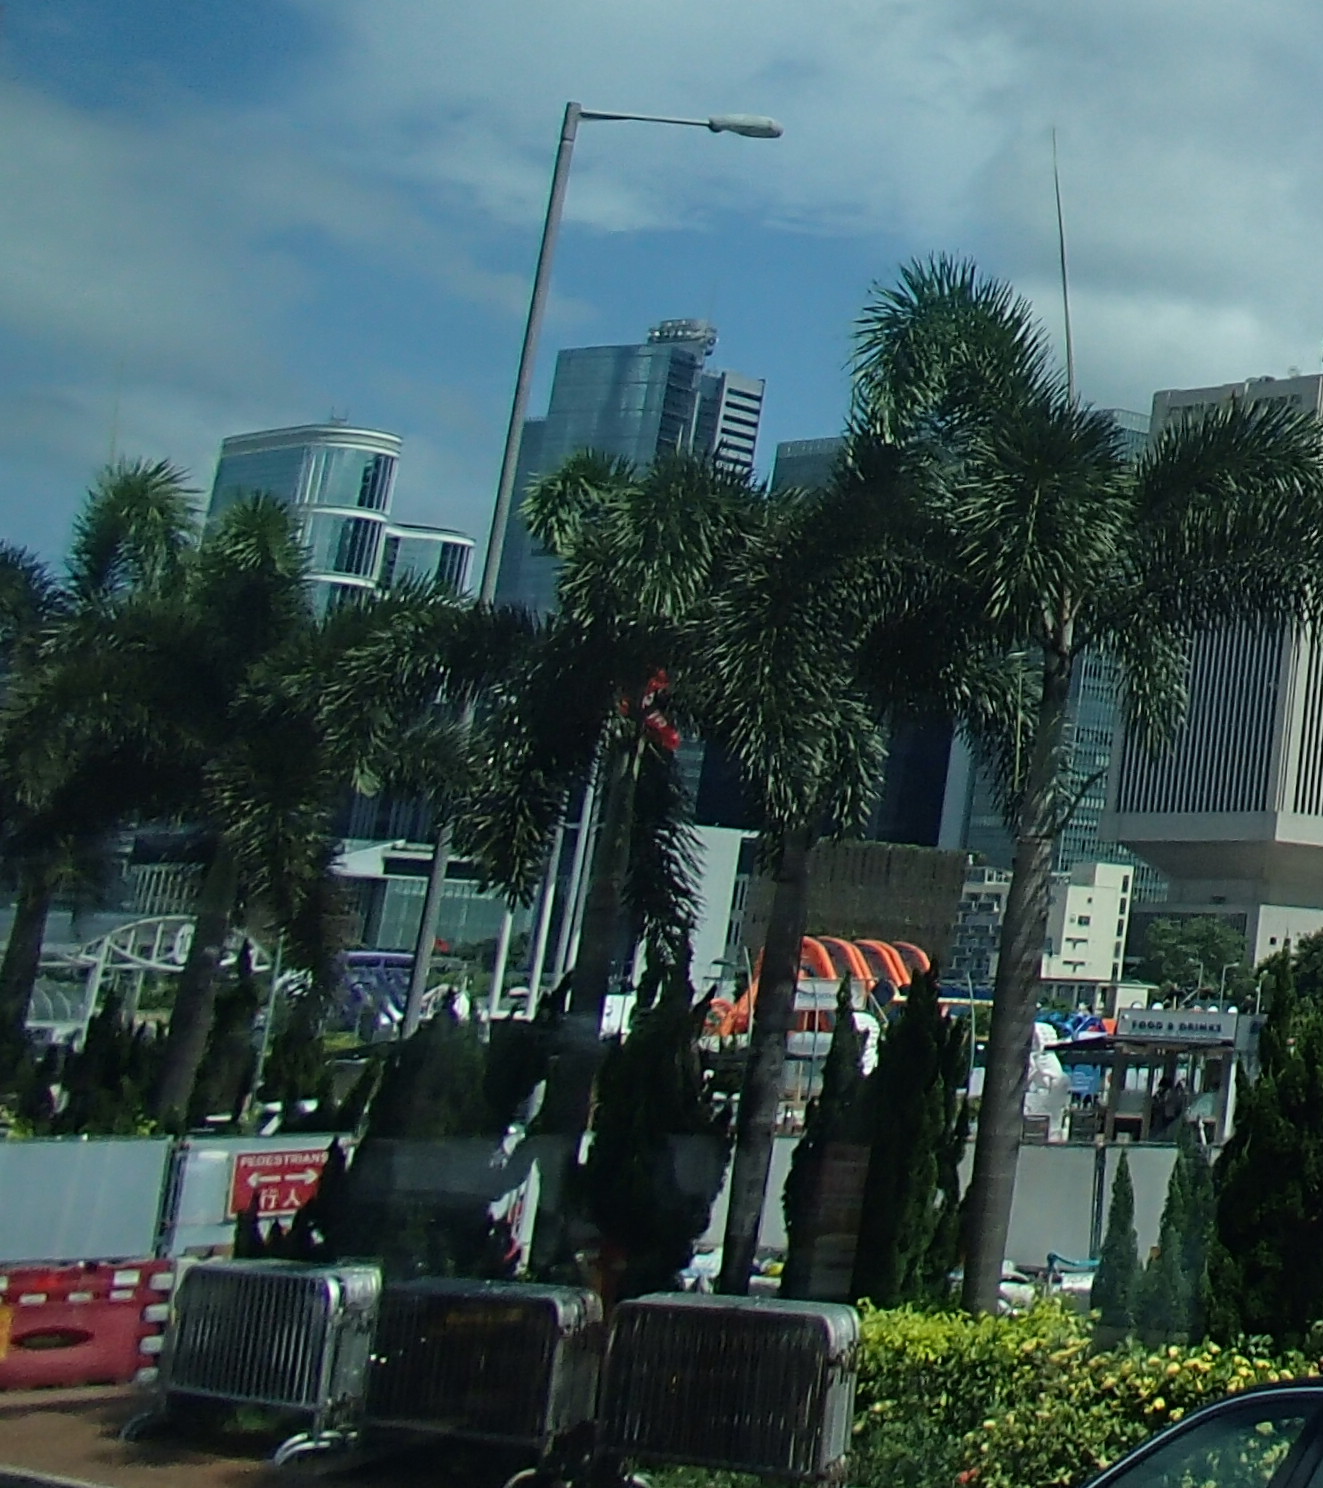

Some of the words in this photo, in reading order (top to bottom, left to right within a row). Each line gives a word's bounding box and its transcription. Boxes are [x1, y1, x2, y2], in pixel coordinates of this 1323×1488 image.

[1132, 1019, 1163, 1030] FOOD
[1178, 1021, 1222, 1033] DRINKS
[240, 1152, 329, 1167] PEDESTRIANS
[259, 1186, 301, 1209] 行人
